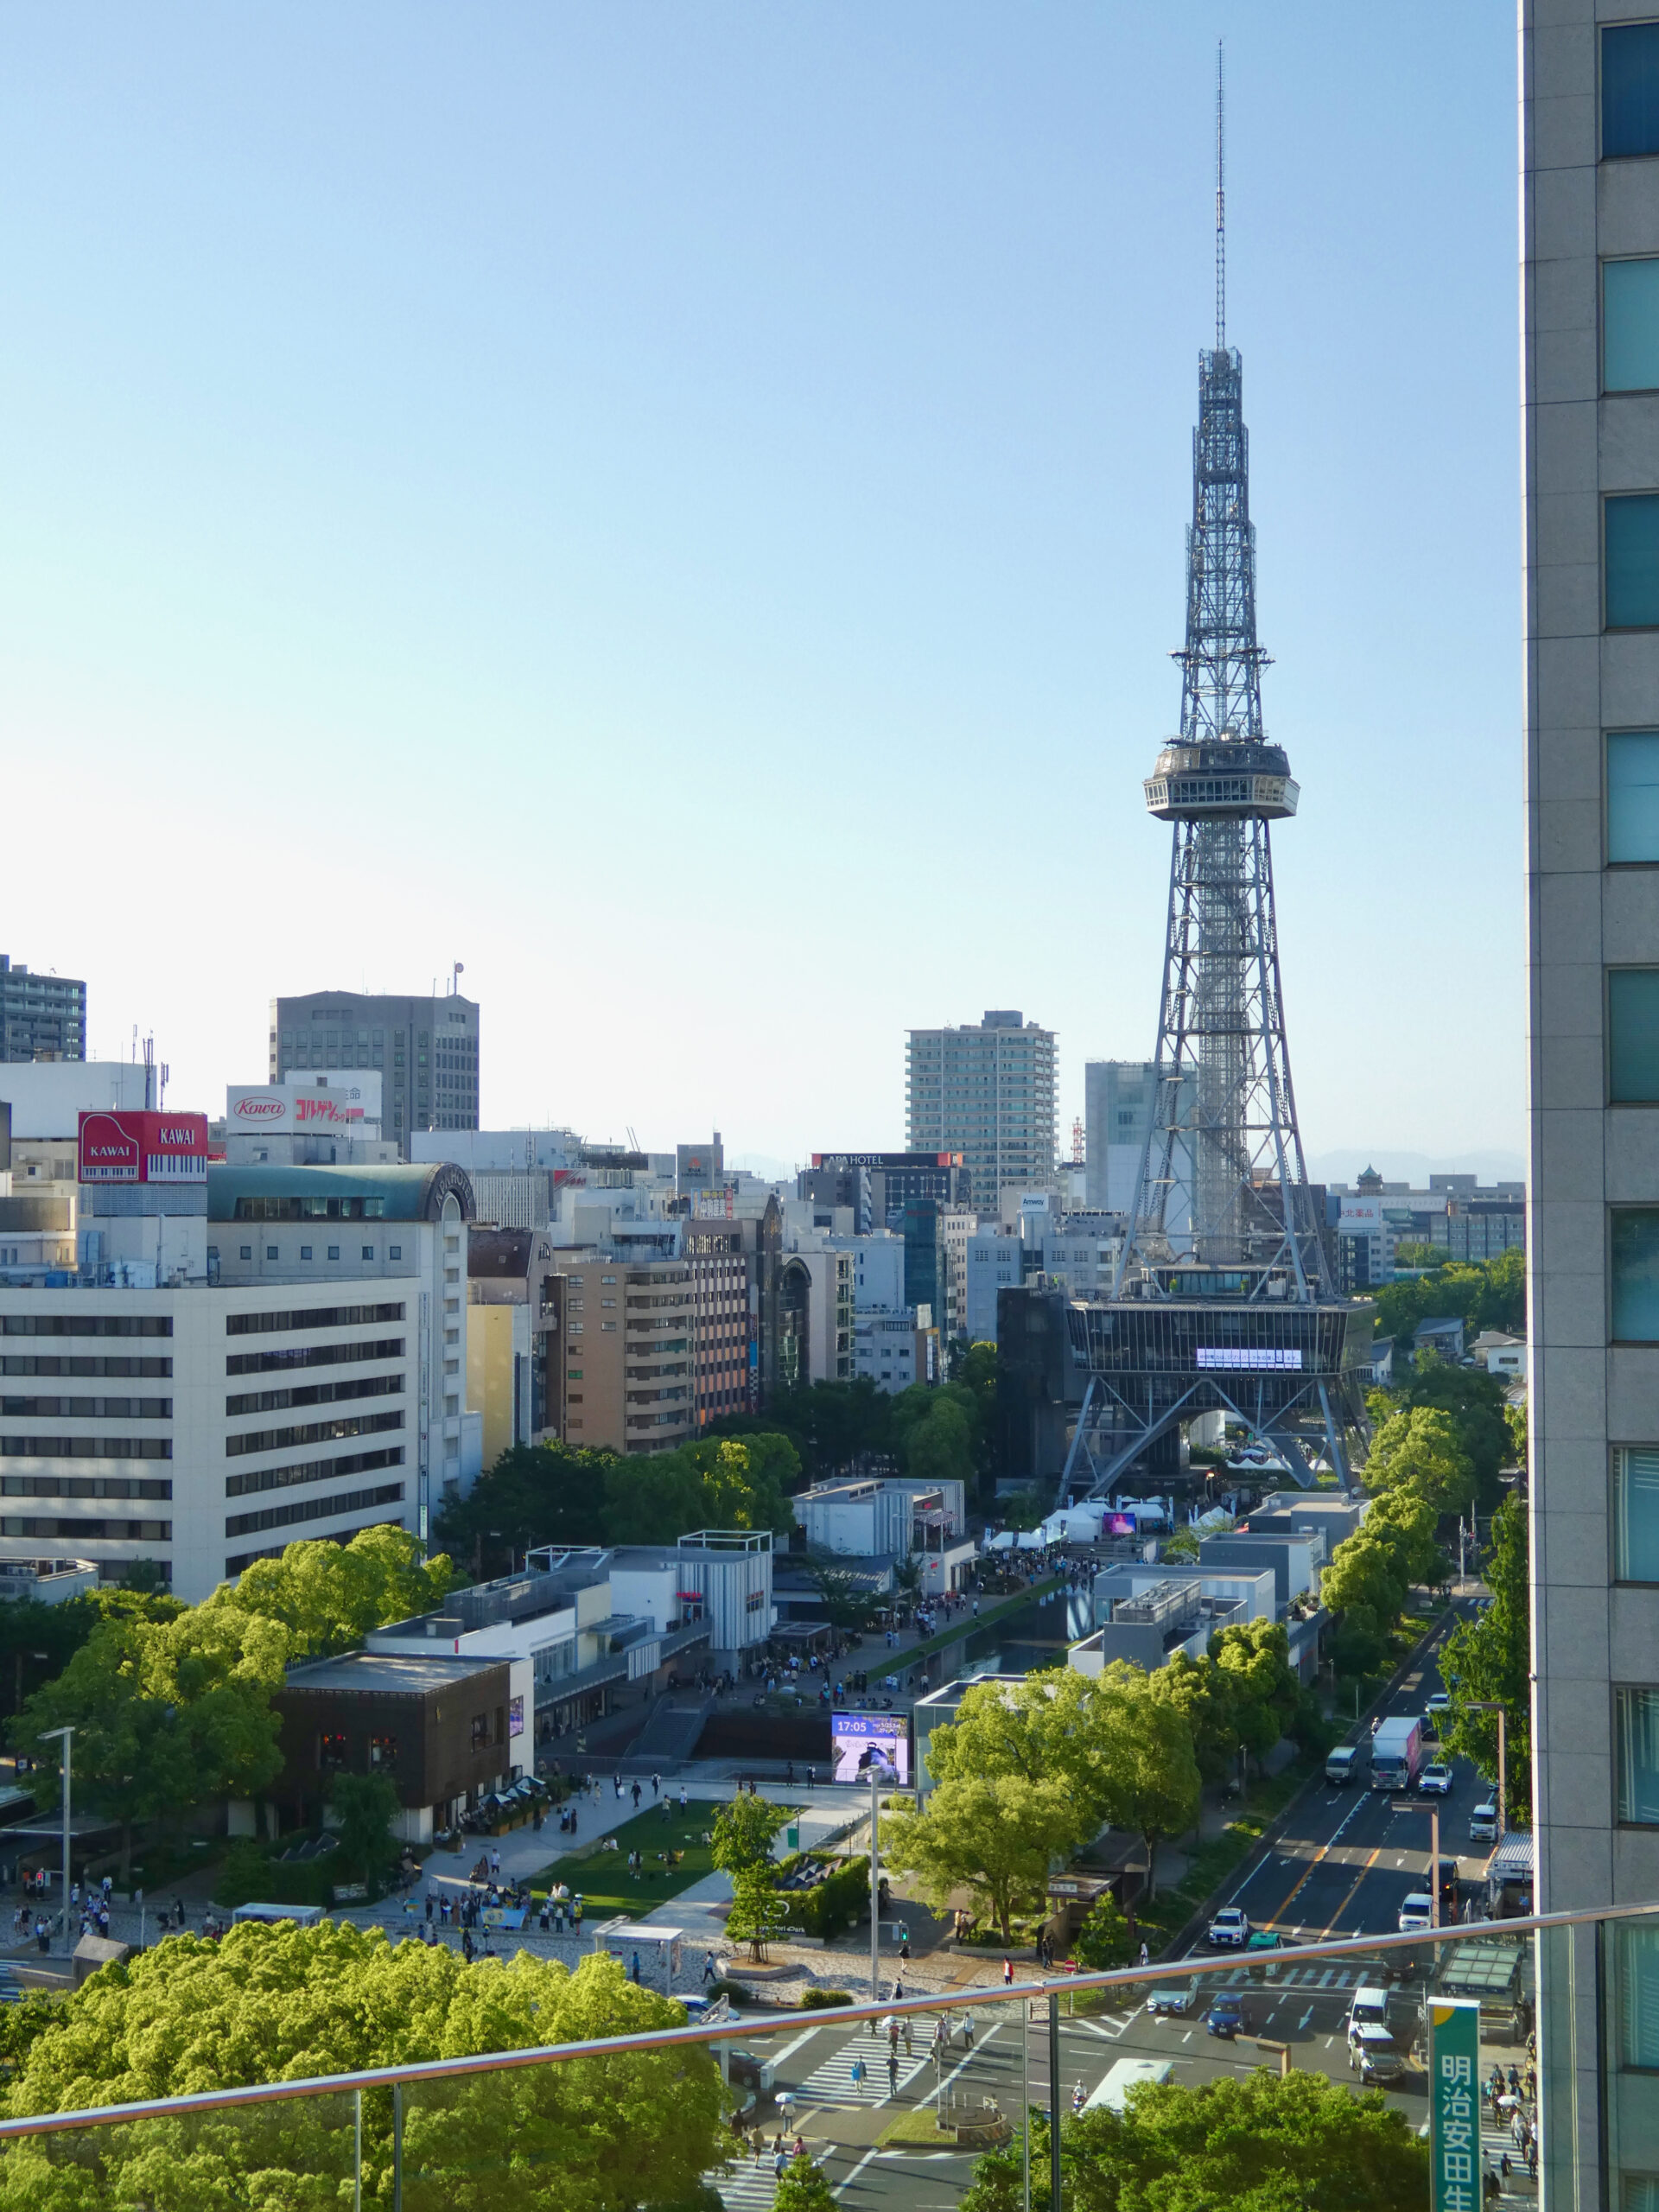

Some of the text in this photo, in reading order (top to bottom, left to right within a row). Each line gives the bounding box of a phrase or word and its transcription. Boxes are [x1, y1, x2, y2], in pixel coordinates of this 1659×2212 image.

[238, 1101, 283, 1115] Kowa
[160, 1128, 194, 1145] KAWAI
[91, 1147, 130, 1156] KAWAI
[850, 1155, 884, 1165] HOTEL
[837, 1720, 867, 1732] 17:05
[1441, 2055, 1472, 2212] 明治安田生
